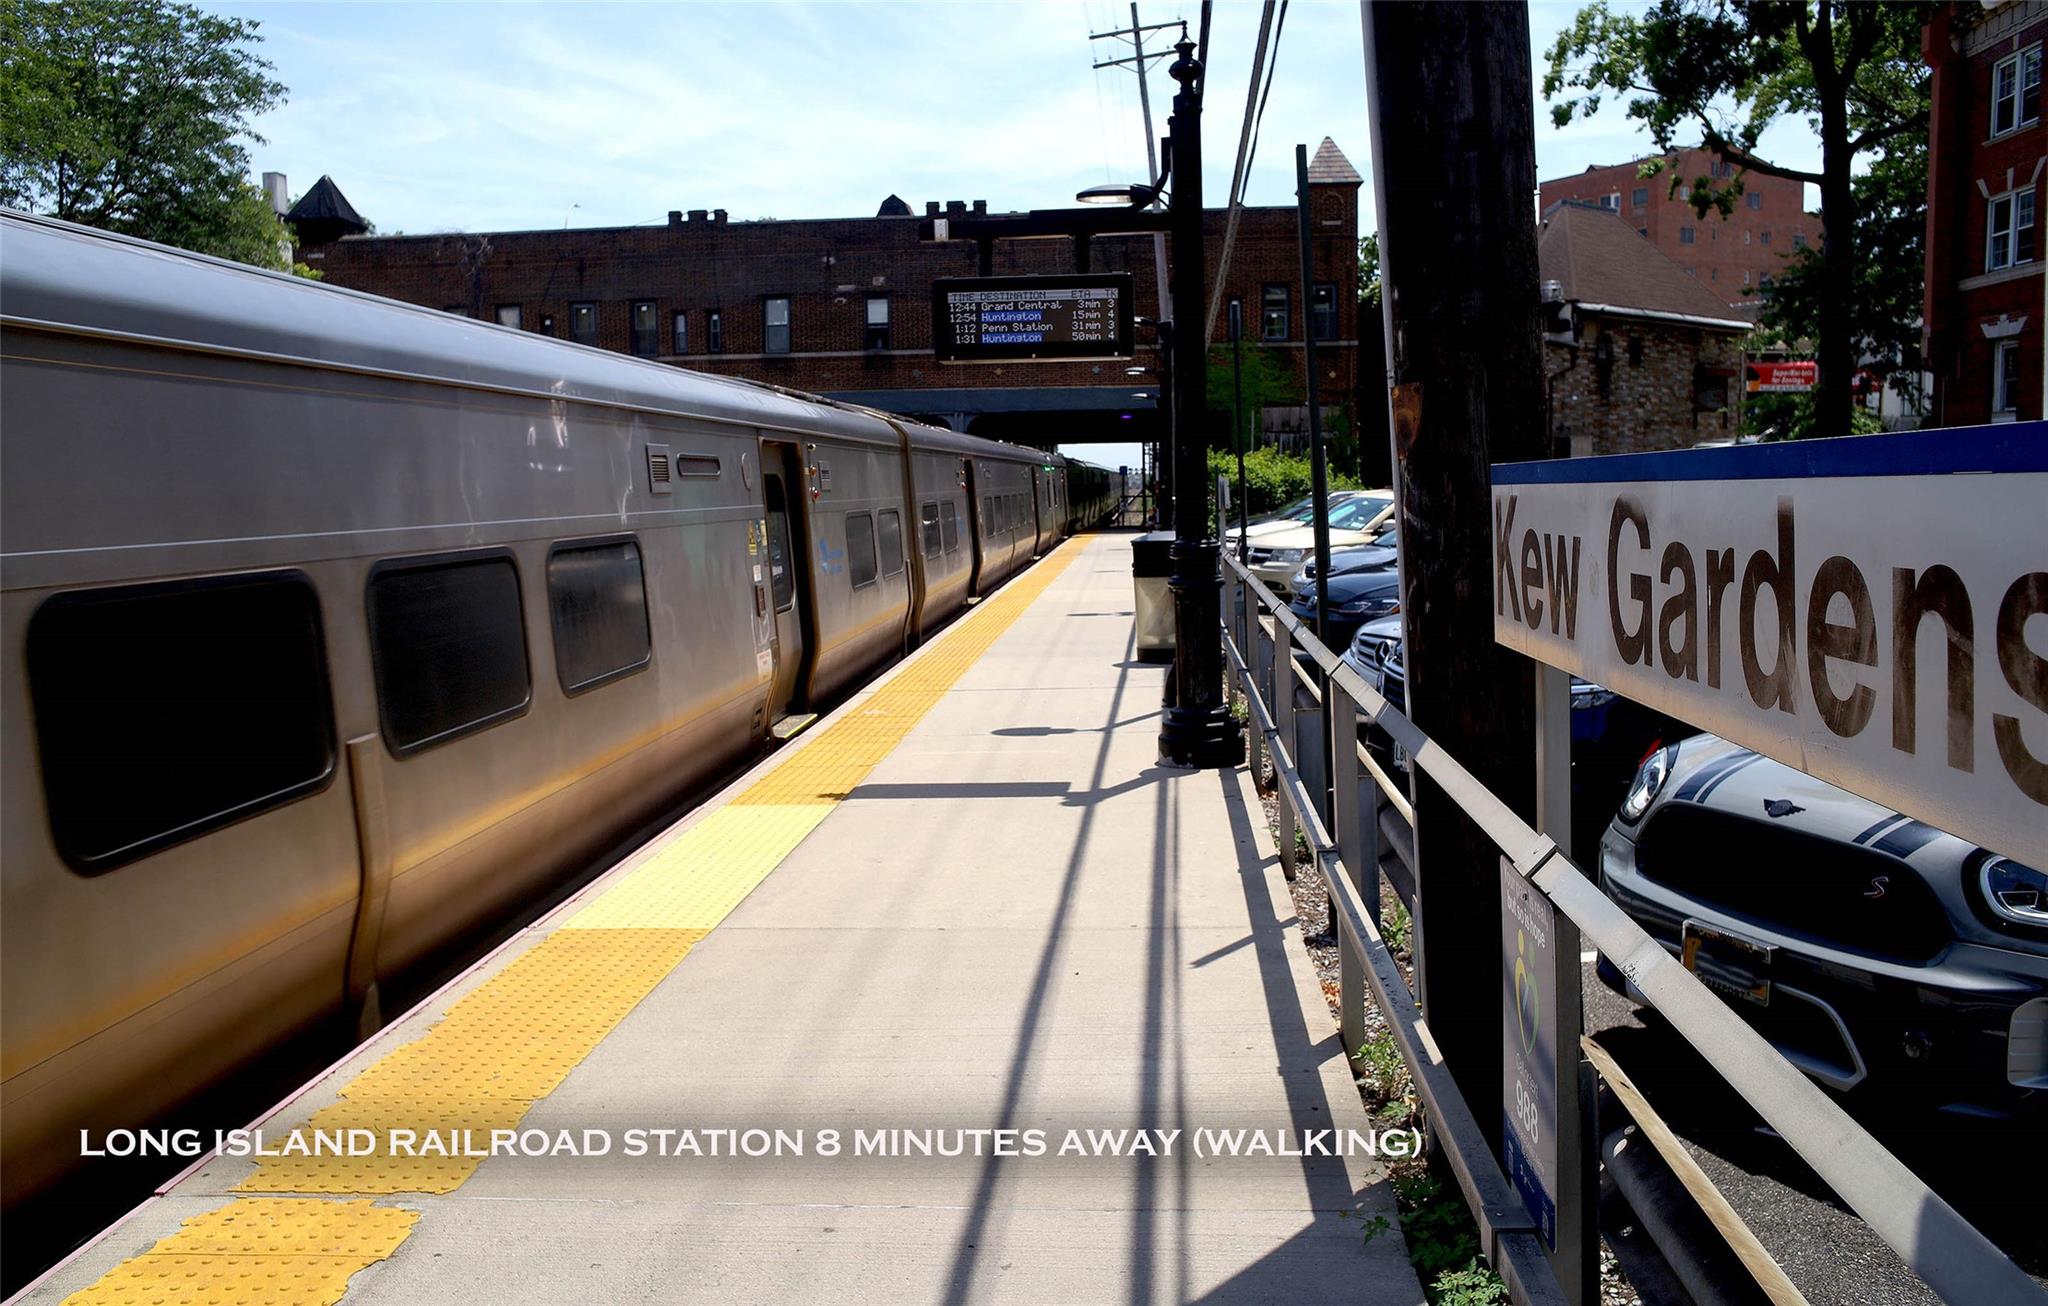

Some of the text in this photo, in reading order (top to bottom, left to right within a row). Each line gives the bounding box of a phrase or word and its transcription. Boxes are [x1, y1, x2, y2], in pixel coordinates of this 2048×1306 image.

[951, 289, 1118, 301] TIME DESTINATION ETA TK
[949, 299, 1115, 312] 12:44 Grand Central 3min 3
[950, 310, 1115, 323] 12:54 Huntington 15min 4
[956, 321, 1115, 333] 1:12 Penn Station 31min 3
[956, 331, 1115, 344] 1:31 Huntington 50min 4
[1495, 492, 2048, 808] Kew Gardens
[1516, 1079, 1538, 1145] 988
